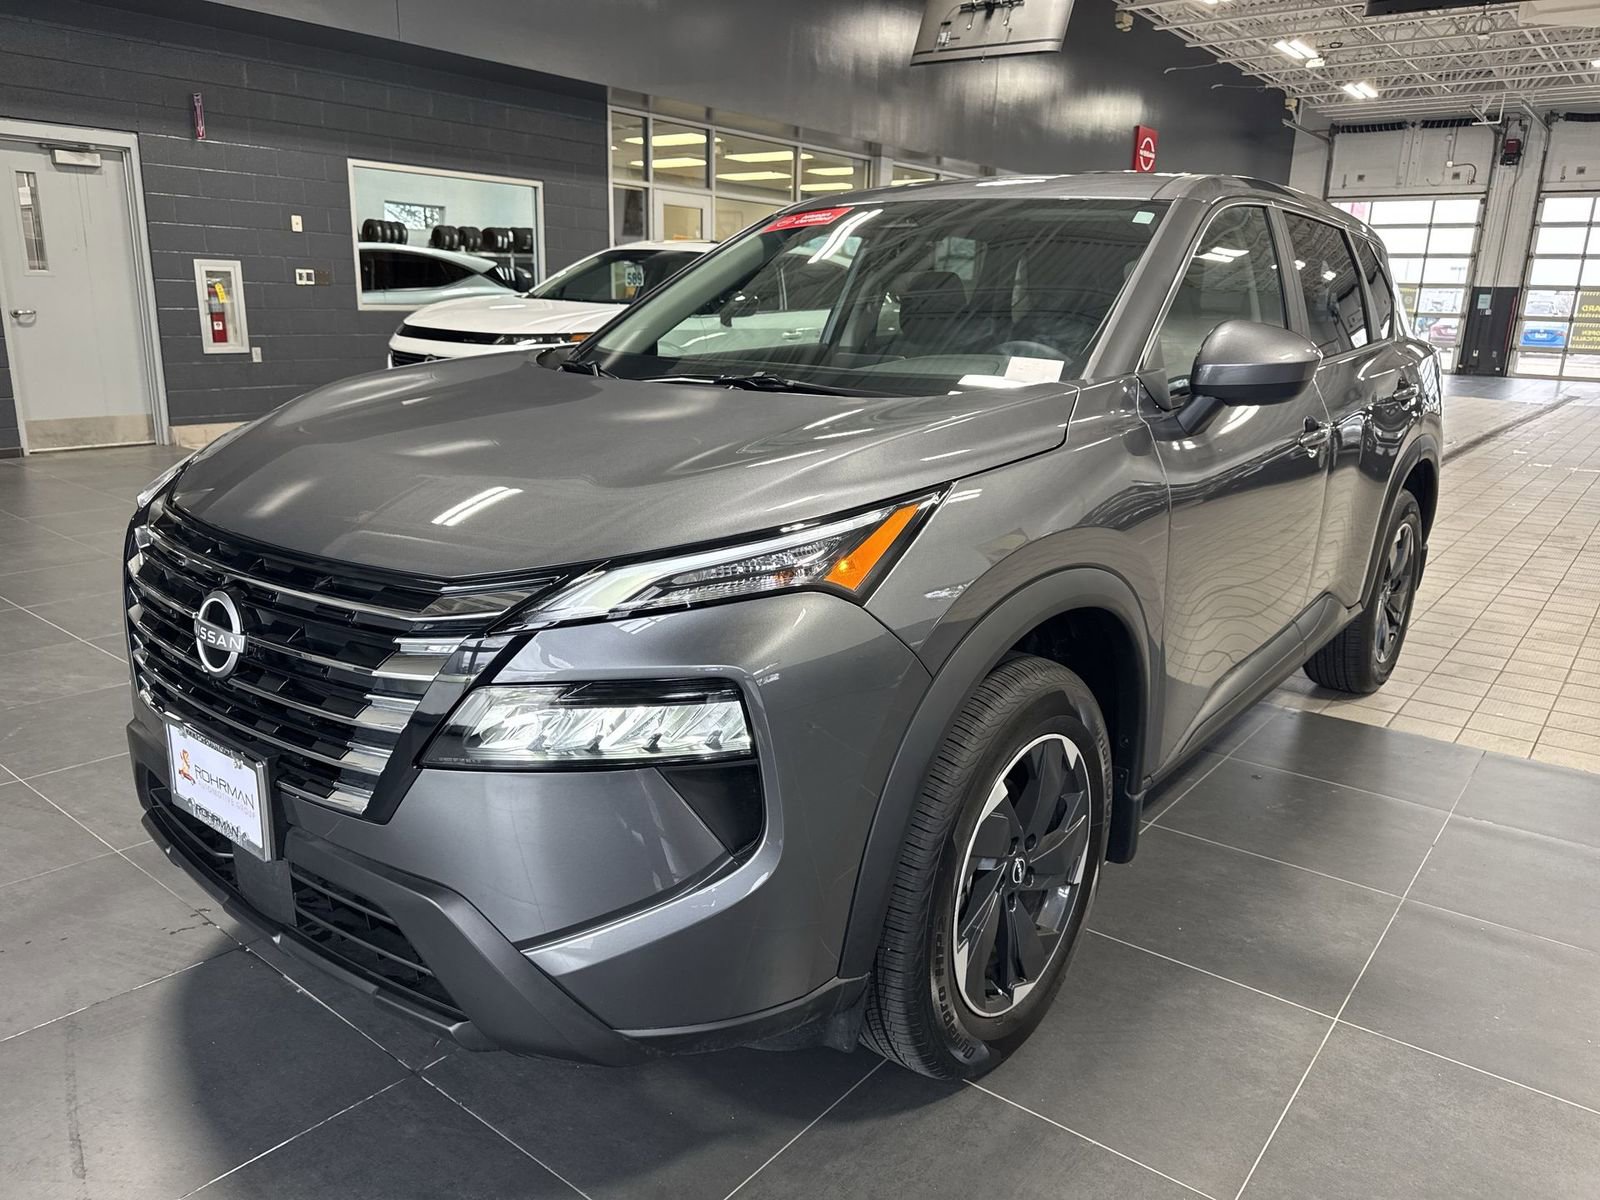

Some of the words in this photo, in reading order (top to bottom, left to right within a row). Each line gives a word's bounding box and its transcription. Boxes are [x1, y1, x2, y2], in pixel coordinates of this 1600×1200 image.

[194, 619, 242, 650] NISSAN
[194, 763, 255, 811] ROHRMAN
[194, 803, 240, 838] ROHRMAN
